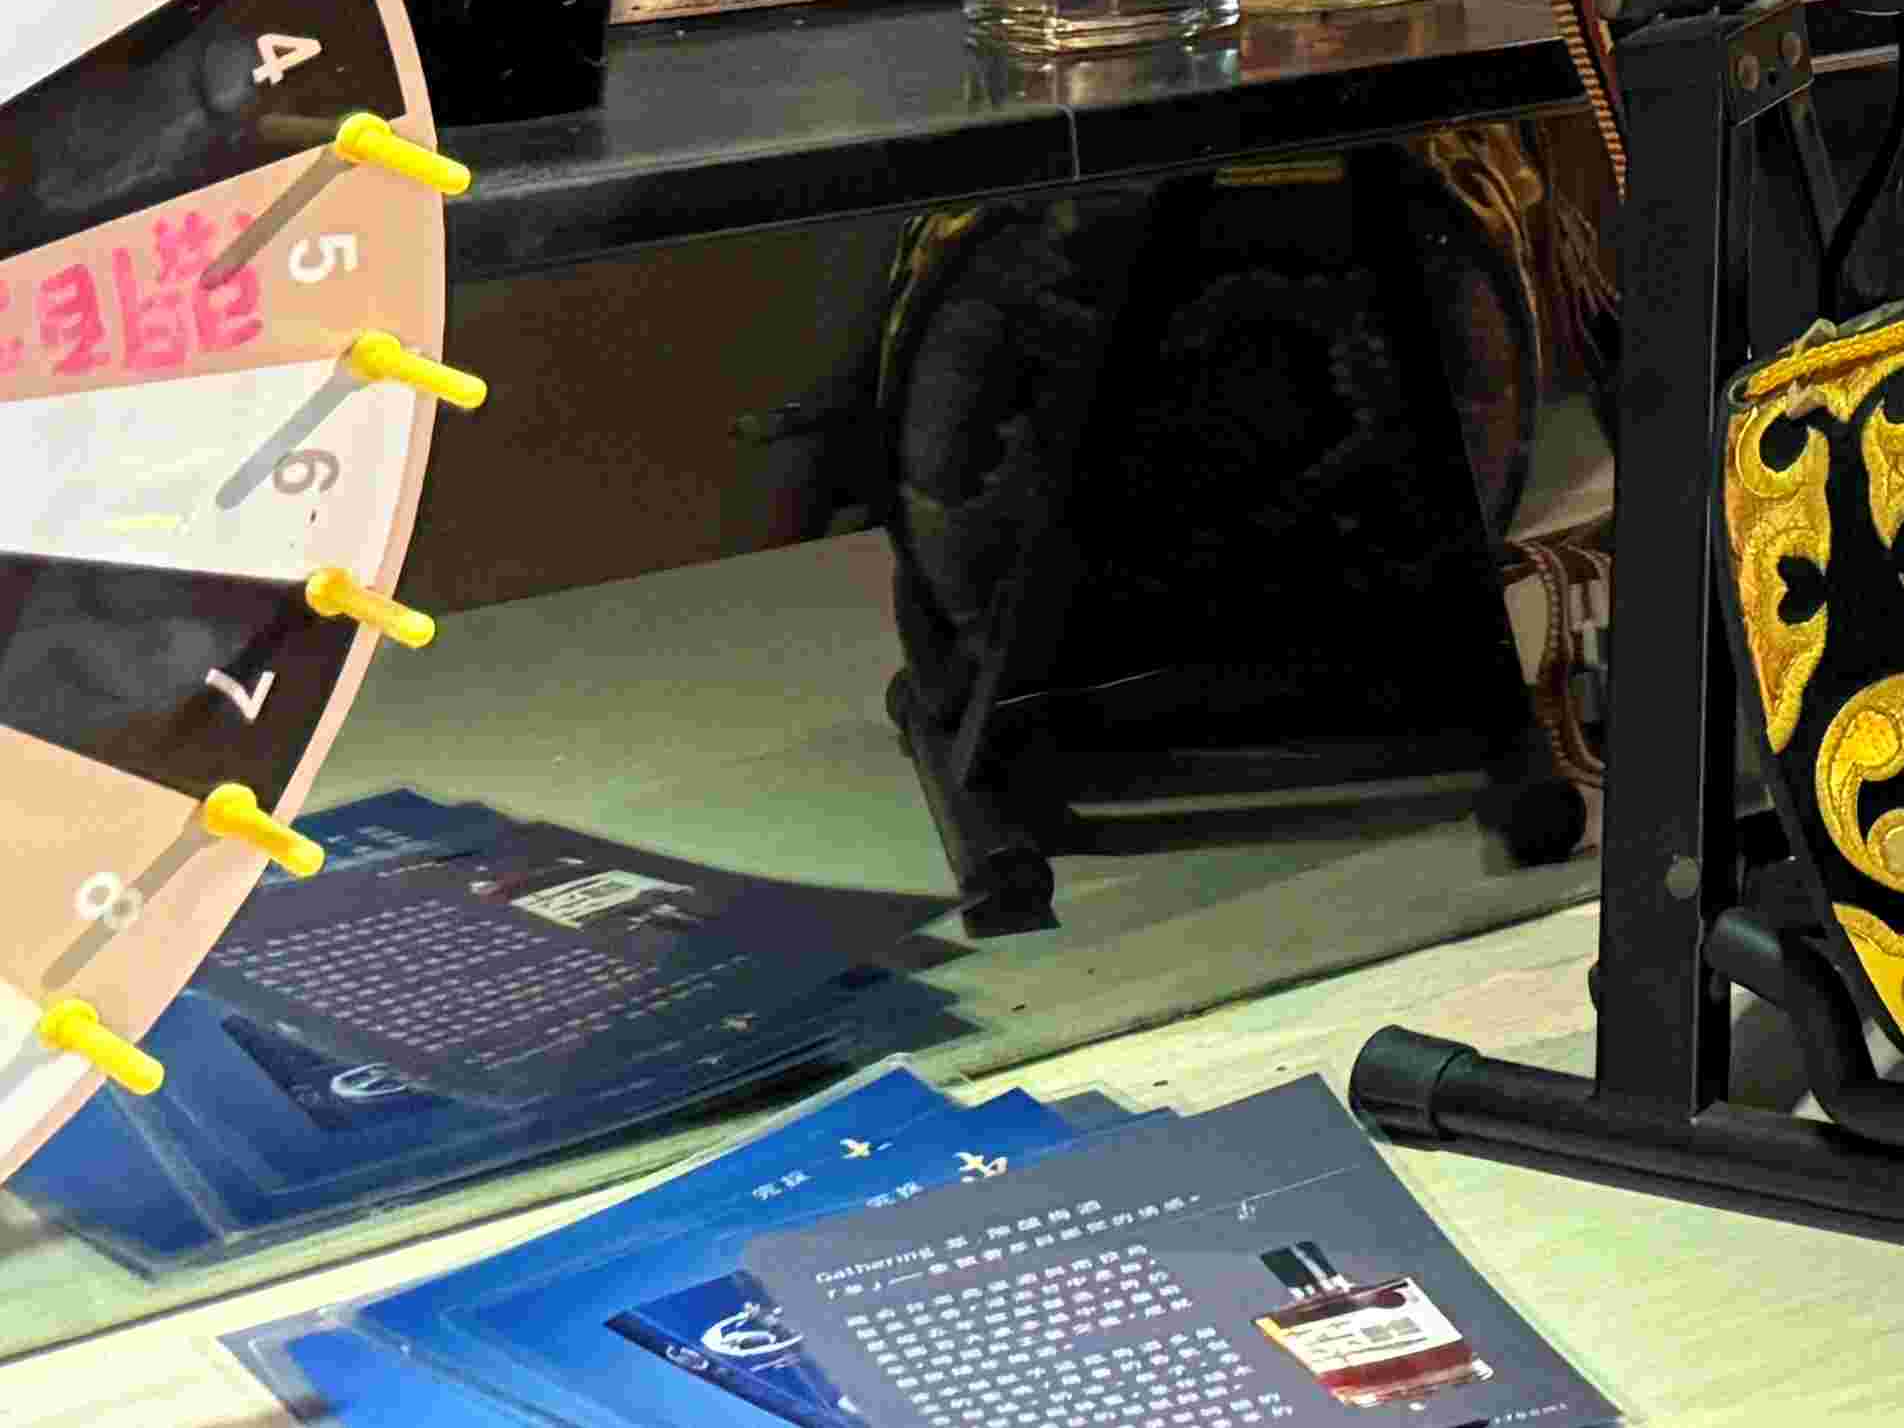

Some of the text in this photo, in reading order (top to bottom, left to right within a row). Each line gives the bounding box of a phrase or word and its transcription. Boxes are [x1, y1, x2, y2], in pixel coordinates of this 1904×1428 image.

[251, 32, 323, 86] 4
[287, 231, 359, 284] 5
[271, 447, 340, 497] 6
[204, 666, 274, 723] 7
[74, 871, 144, 931] 8
